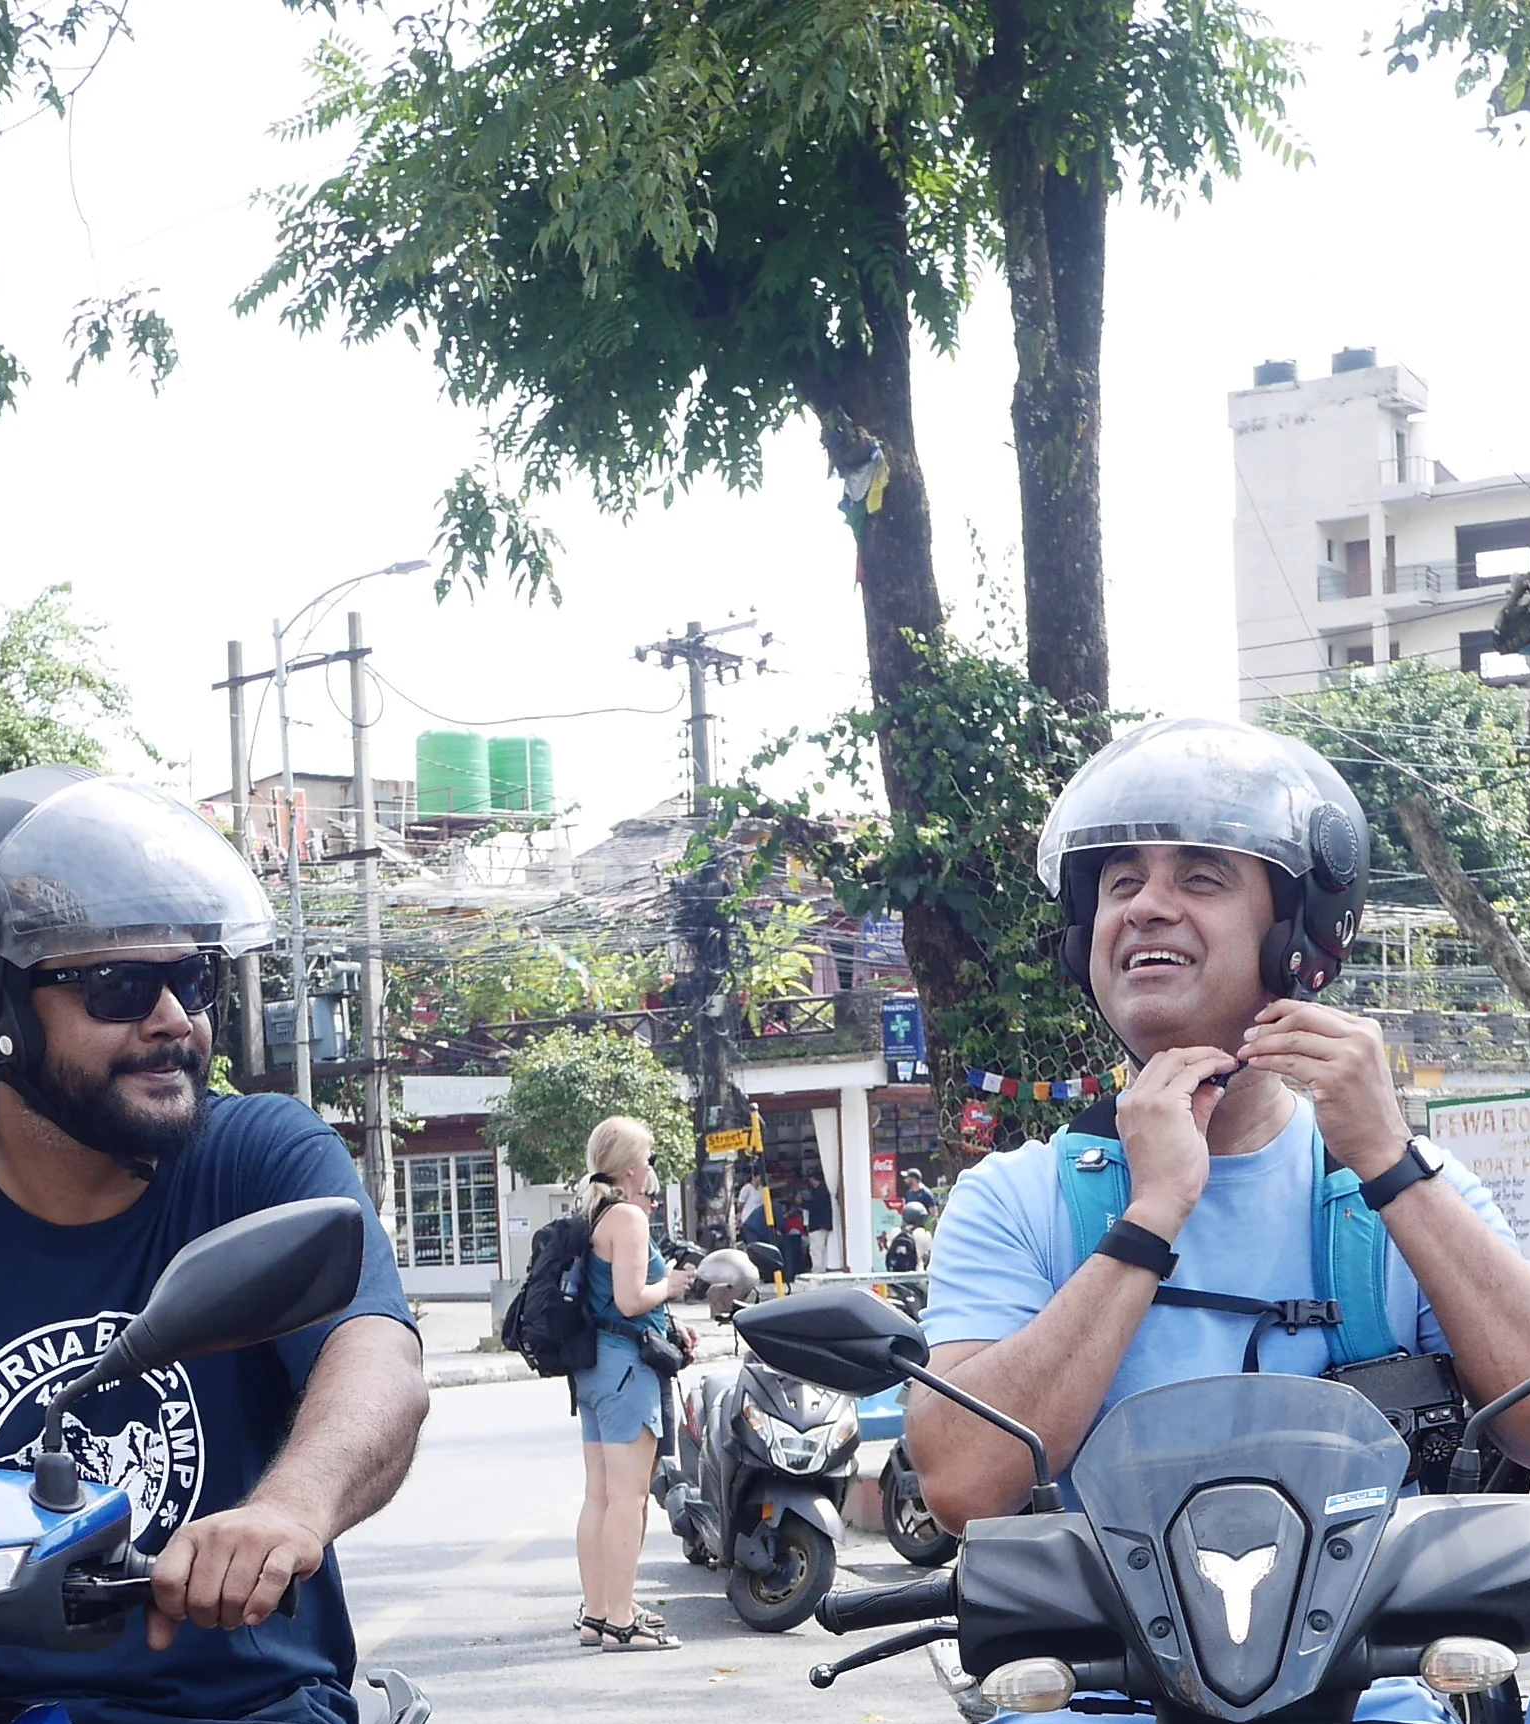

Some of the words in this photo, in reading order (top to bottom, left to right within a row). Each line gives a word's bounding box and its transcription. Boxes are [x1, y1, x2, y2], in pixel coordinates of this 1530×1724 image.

[883, 1003, 916, 1012] PHARMACY
[1435, 1109, 1496, 1138] FEWA
[708, 1132, 741, 1146] Street
[742, 1129, 752, 1146] 7
[1474, 1157, 1513, 1175] BOAT
